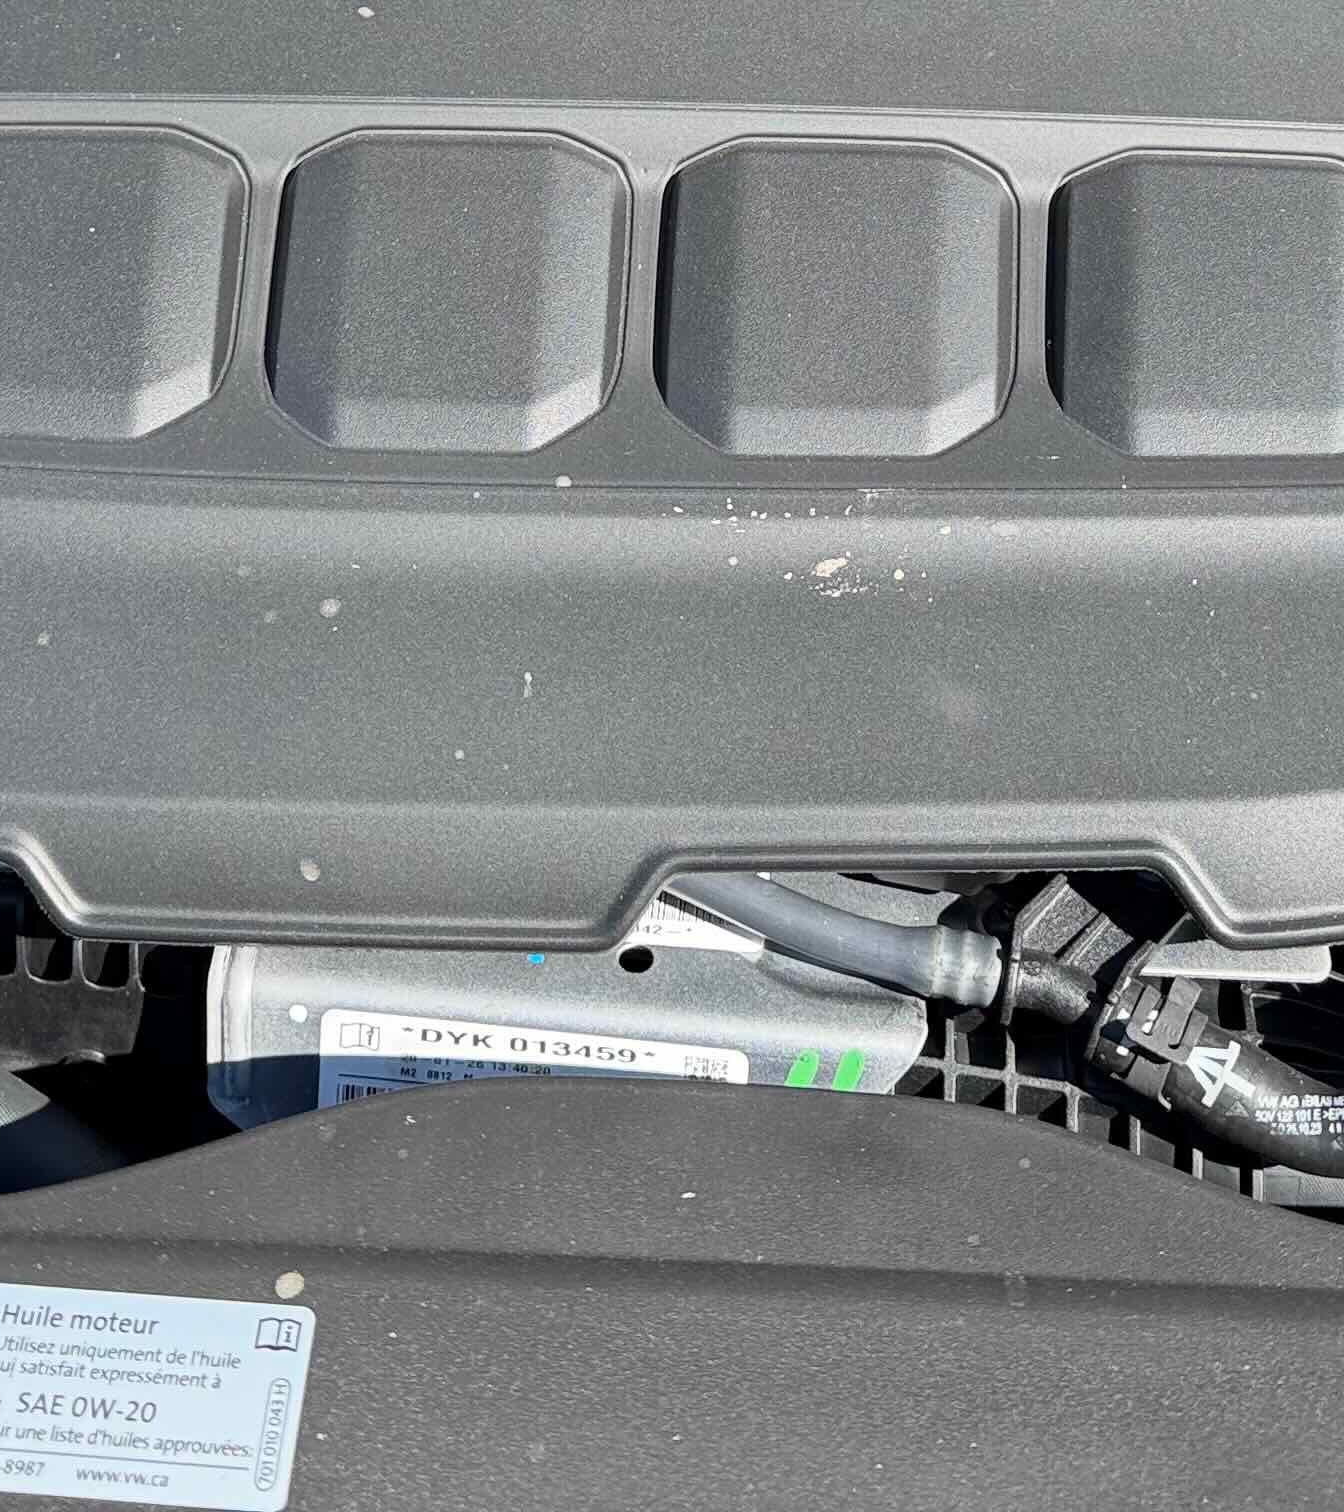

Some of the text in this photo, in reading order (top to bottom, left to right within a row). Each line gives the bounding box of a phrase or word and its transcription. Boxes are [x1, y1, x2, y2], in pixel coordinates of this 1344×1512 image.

[0, 1304, 64, 1328] Huile
[69, 1311, 160, 1335] moteur
[59, 1343, 161, 1363] uniquement
[166, 1349, 187, 1366] de
[190, 1351, 241, 1370] l'huile
[20, 1360, 86, 1378] satisfait
[90, 1366, 206, 1388] expressément
[211, 1375, 222, 1389] à
[16, 1392, 64, 1417] SAE
[71, 1396, 156, 1423] 0W-20
[269, 1399, 285, 1426] 043
[15, 1428, 47, 1441] une
[50, 1425, 85, 1445] liste
[88, 1429, 149, 1449] d'huiles
[264, 1430, 279, 1456] 010
[76, 1466, 169, 1488] www.vw.ca
